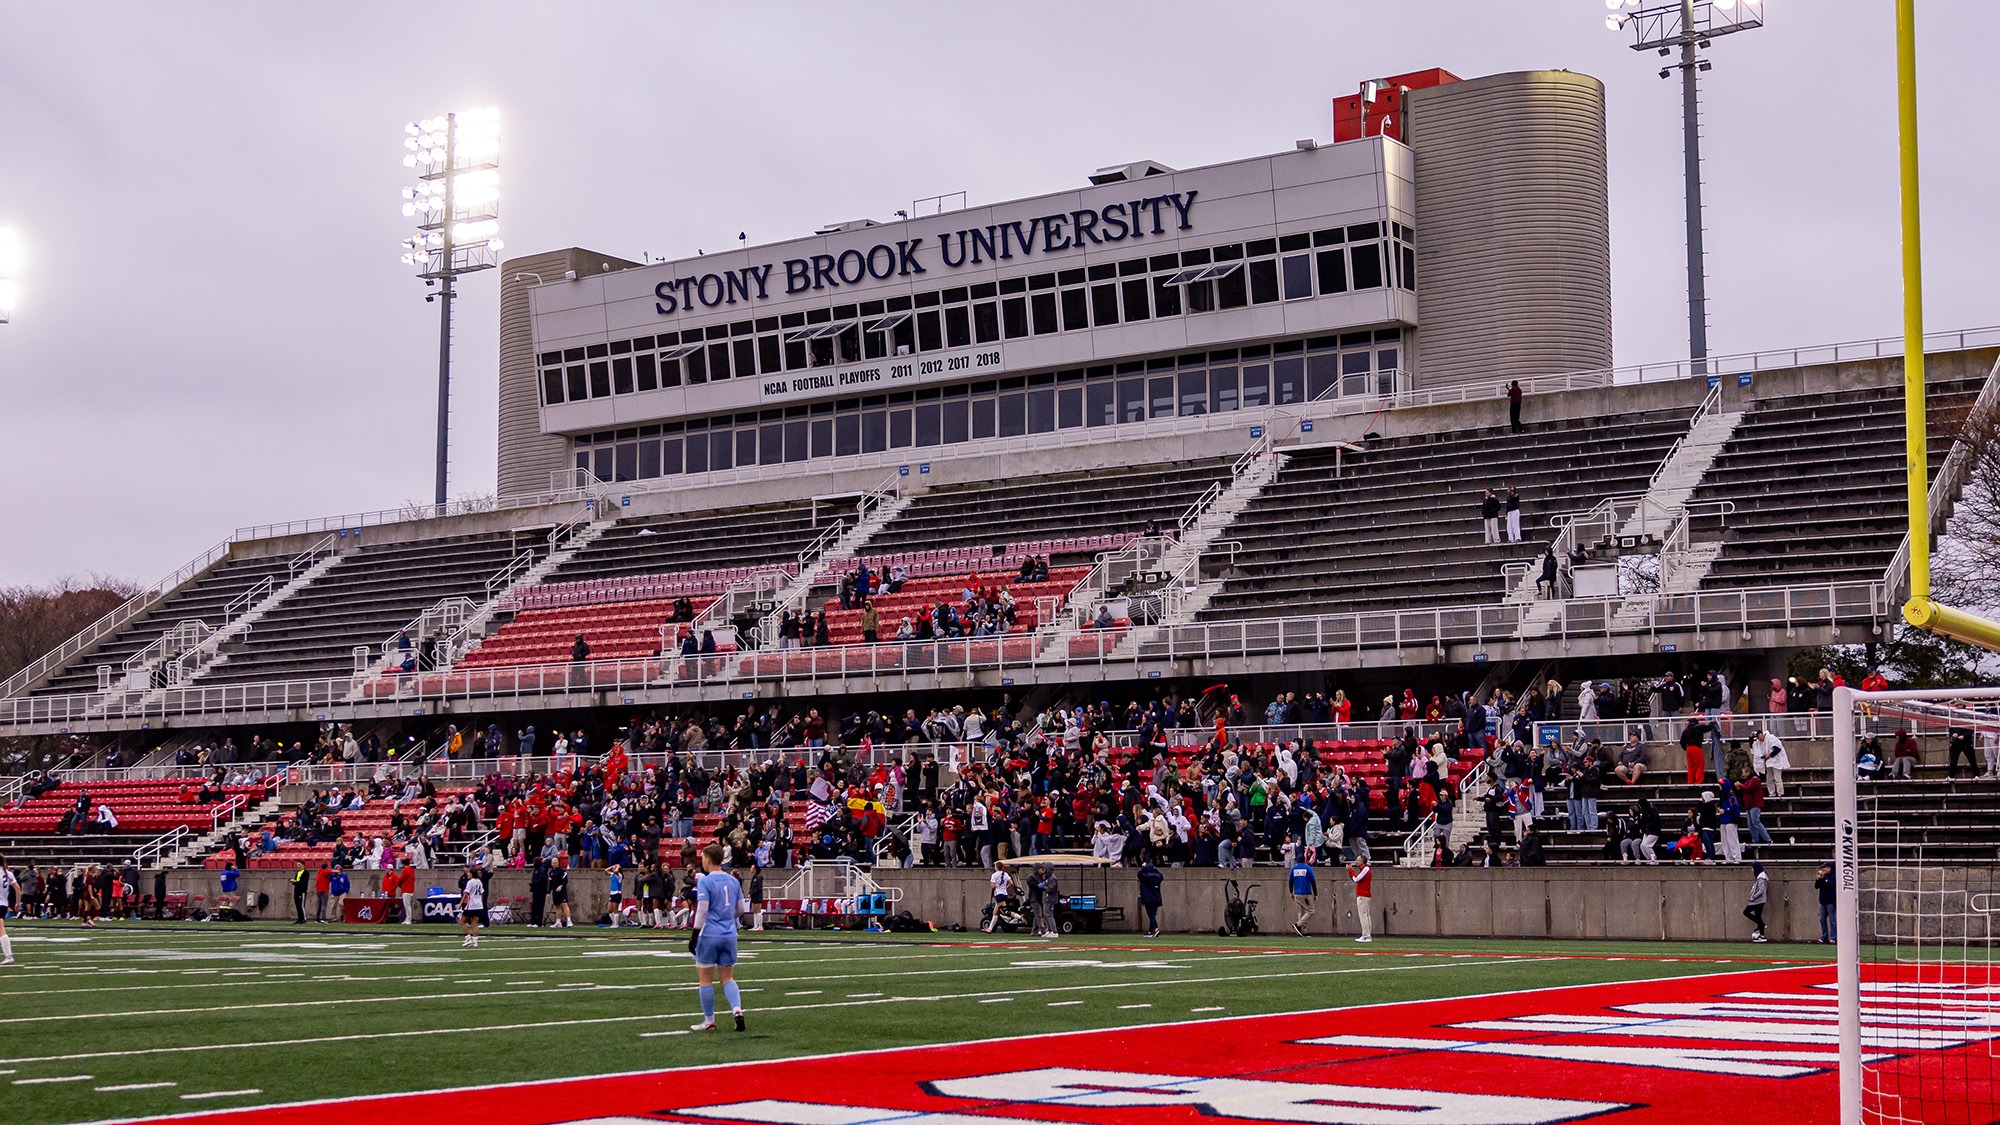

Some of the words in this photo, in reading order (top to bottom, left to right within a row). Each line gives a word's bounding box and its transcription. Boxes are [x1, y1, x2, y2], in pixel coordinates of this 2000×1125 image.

[655, 264, 773, 315] STONY
[785, 238, 926, 294] BROOK
[937, 190, 1199, 268] UNIVERSITY
[764, 382, 788, 396] NCAA
[792, 375, 835, 392] FOOTBALL
[839, 368, 881, 386] PLAYOFFS
[891, 364, 913, 379] 2011
[920, 359, 943, 375] 2012
[948, 355, 970, 371] 2017
[976, 350, 1001, 367] 2018
[424, 902, 454, 917] CAA
[723, 884, 731, 907] 1
